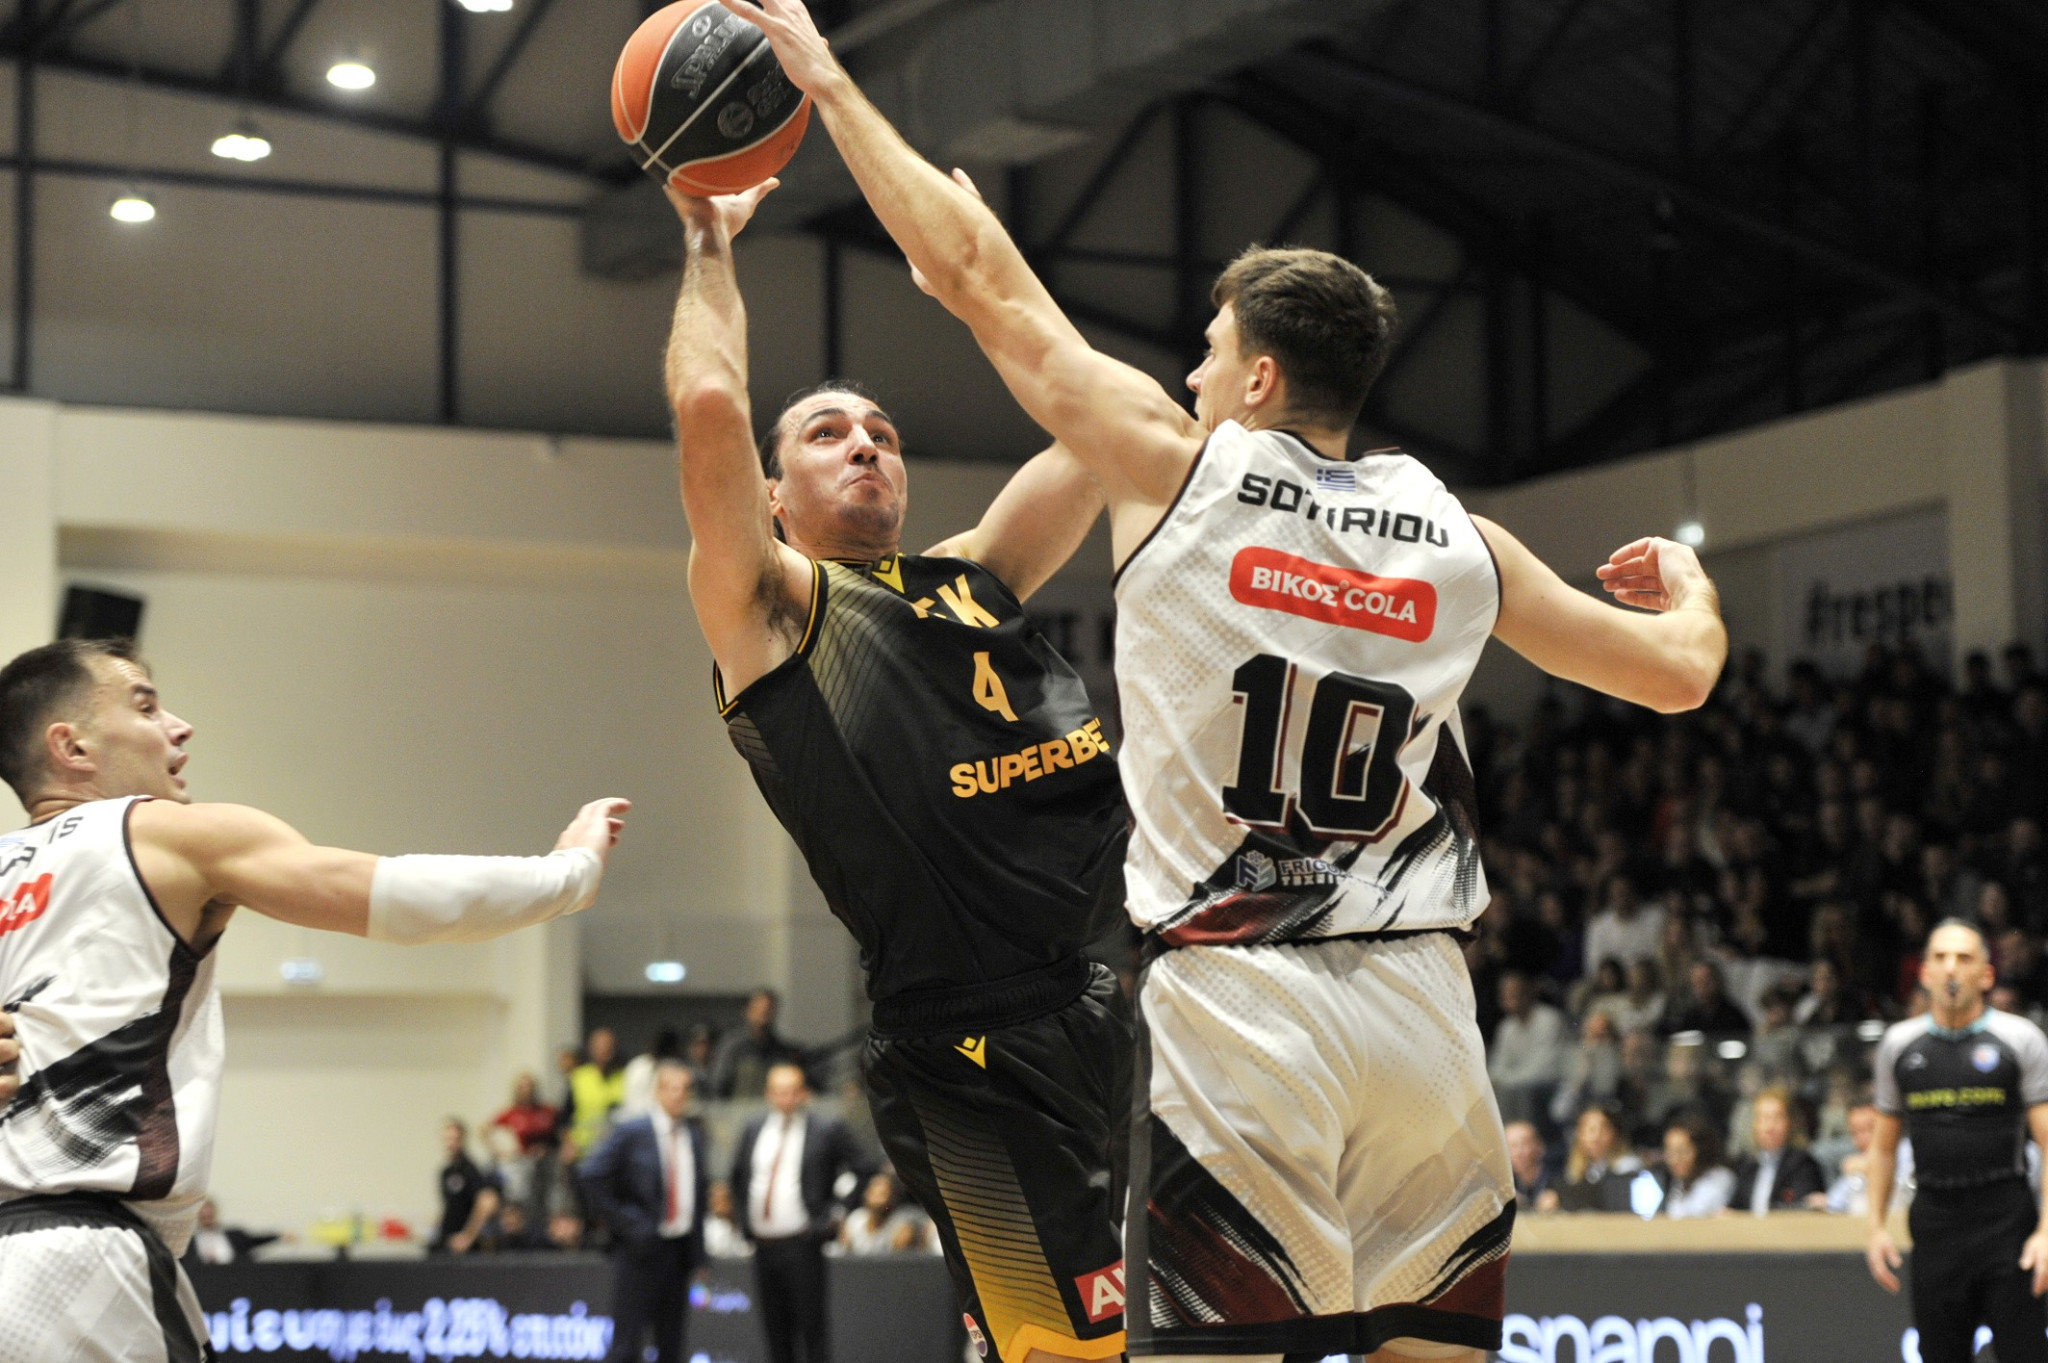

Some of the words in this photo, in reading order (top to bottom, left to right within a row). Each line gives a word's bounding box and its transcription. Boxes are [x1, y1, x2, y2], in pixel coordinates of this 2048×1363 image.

[1344, 588, 1417, 625] COLA
[972, 651, 1020, 723] 4
[949, 717, 1111, 799] SUPERBE
[1222, 652, 1419, 845] 10
